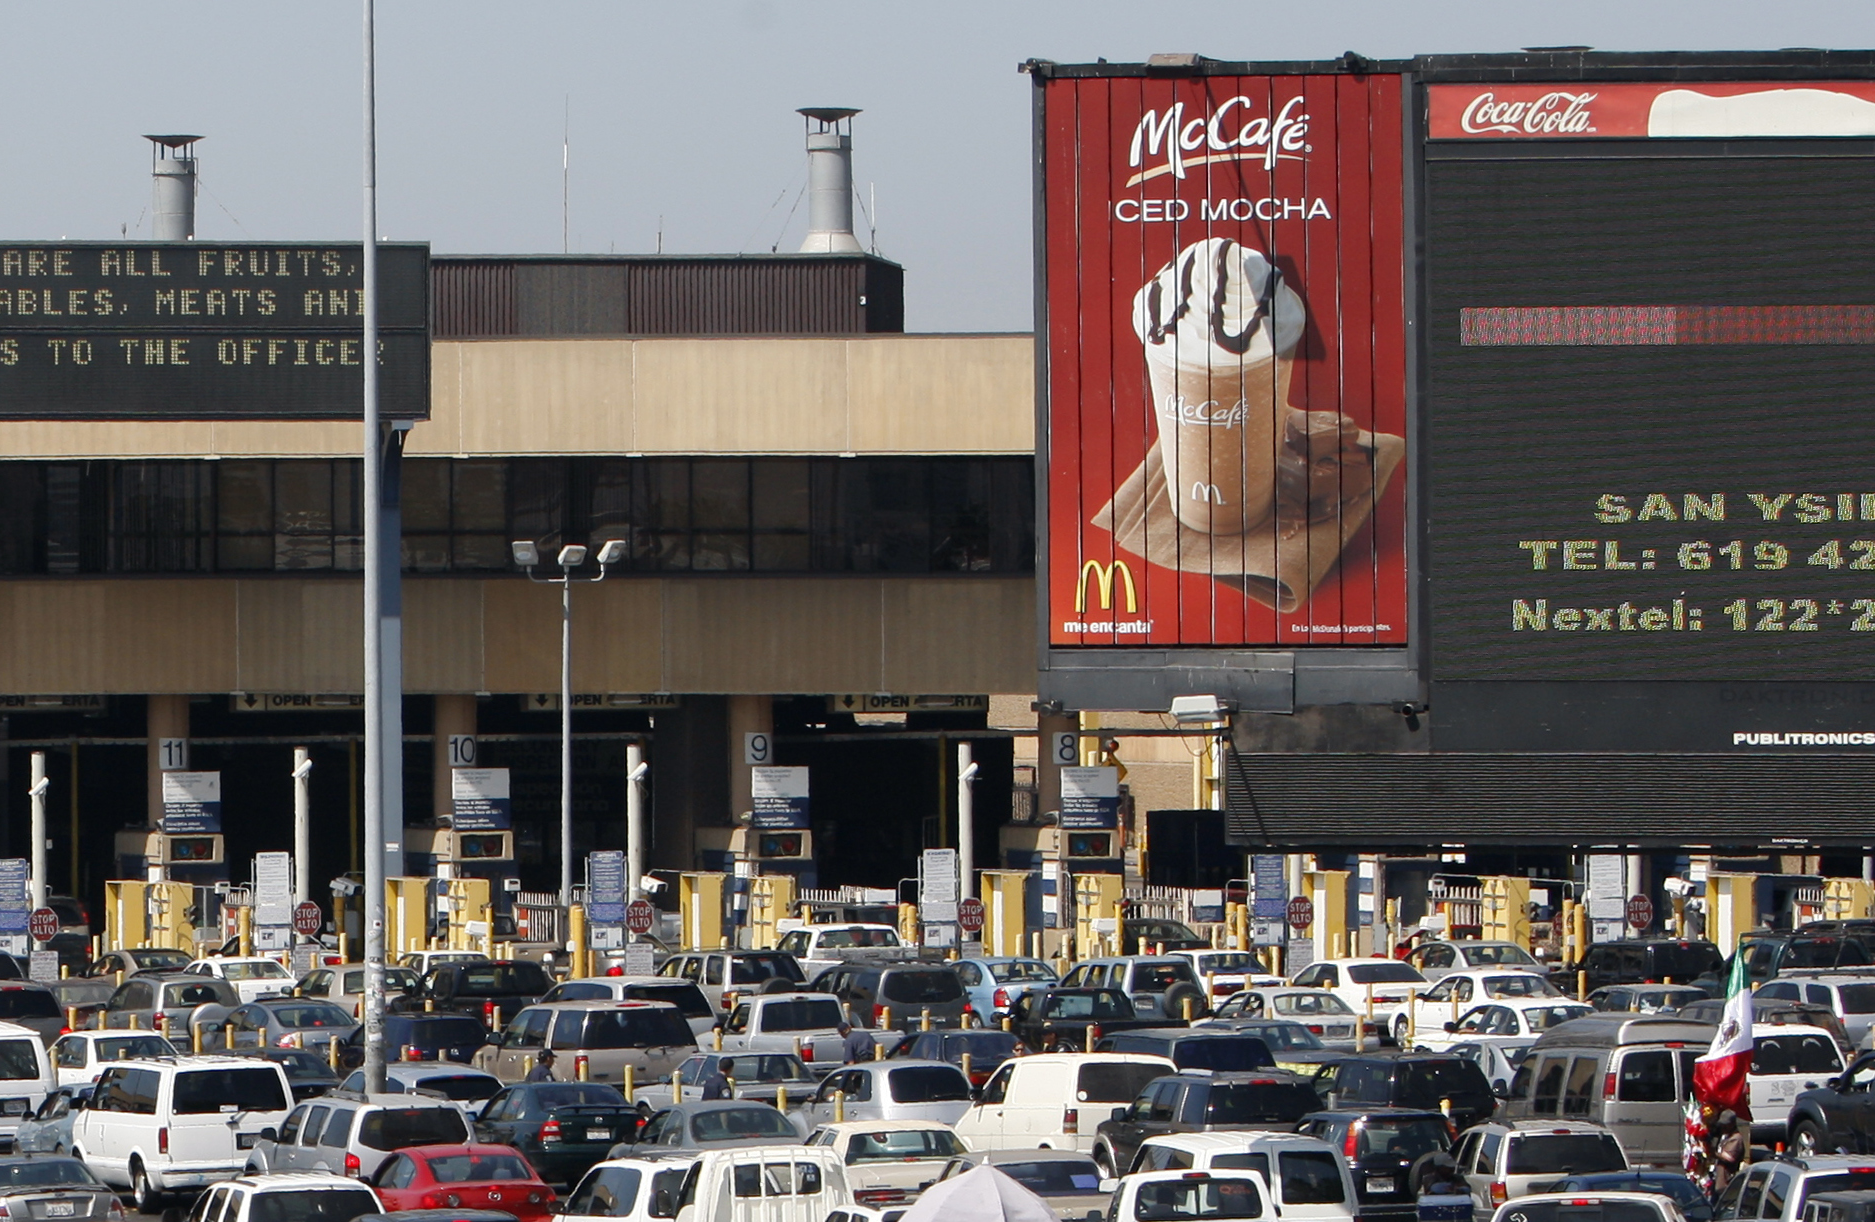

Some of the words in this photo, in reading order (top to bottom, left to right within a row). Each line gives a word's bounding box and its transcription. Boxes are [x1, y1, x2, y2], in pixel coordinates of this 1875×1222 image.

[1460, 91, 1599, 134] Coca-Cola
[1128, 95, 1312, 181] McCafé
[1200, 197, 1332, 222] MOCHA
[100, 249, 171, 277] ALL
[198, 249, 357, 279] FRUITS,
[154, 288, 277, 315] MEATS
[46, 338, 93, 365] TO
[118, 338, 191, 366] THE
[1164, 393, 1250, 430] McCafé
[1593, 492, 1726, 525] SAN
[1518, 539, 1658, 572] TEL:
[1676, 539, 1791, 572] 619
[1510, 598, 1704, 632] Nextel:
[1063, 618, 1088, 634] me
[1089, 617, 1153, 634] encanta
[272, 695, 312, 706] OPEN
[870, 695, 909, 707] OPEN
[1732, 731, 1875, 746] PUBLITRONICS
[162, 741, 184, 767] 11
[450, 737, 475, 764] 10
[751, 735, 767, 761] 9
[1058, 734, 1075, 761] 8
[295, 907, 321, 918] STOP
[627, 907, 653, 917] STOP
[958, 904, 984, 915] STOP
[1288, 902, 1312, 913] STOP
[1627, 901, 1651, 912] STOP
[30, 915, 57, 924] STOP
[296, 919, 319, 930] ALTO
[628, 918, 652, 929] ALTO
[960, 915, 983, 926] ALTO
[1289, 914, 1312, 924] ALTO
[1628, 912, 1651, 922] ALTO
[32, 925, 54, 936] ALTO
